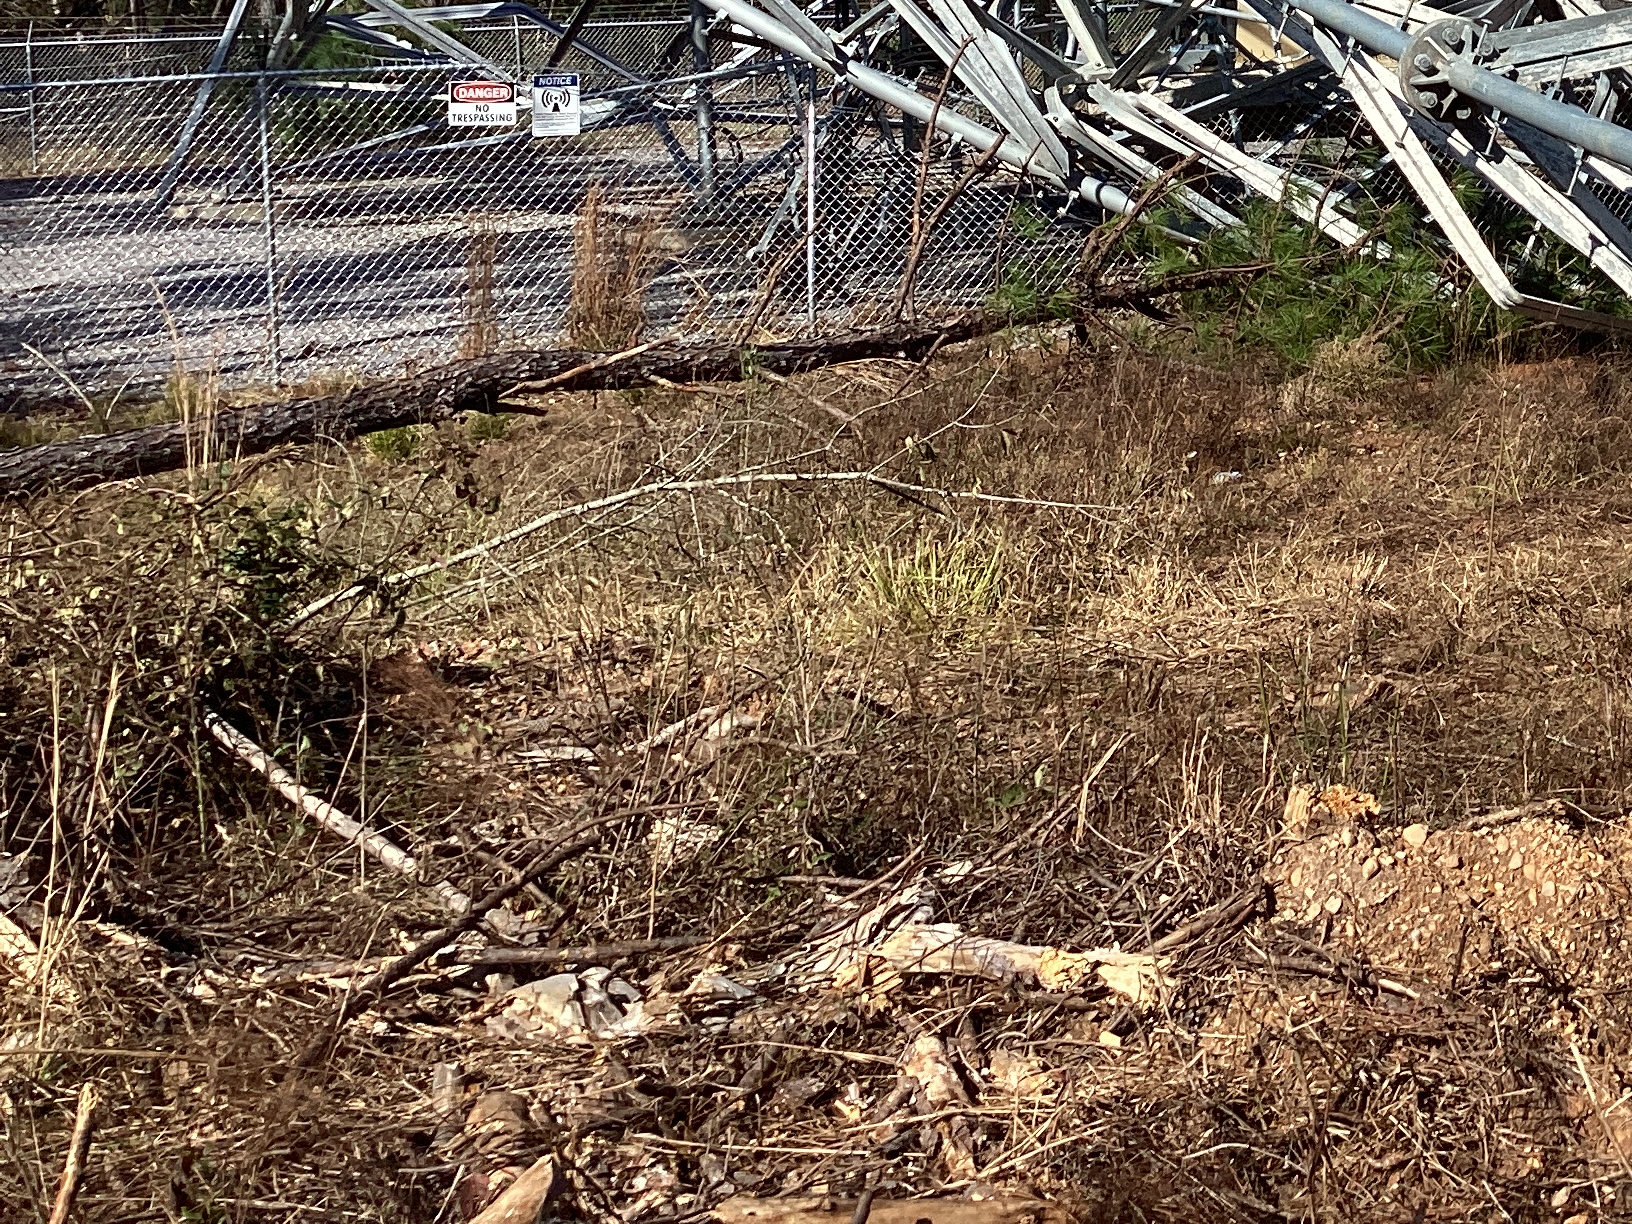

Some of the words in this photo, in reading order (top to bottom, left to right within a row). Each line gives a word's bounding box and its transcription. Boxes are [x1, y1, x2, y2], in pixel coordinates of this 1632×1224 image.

[538, 76, 572, 86] NOTICE
[459, 87, 509, 99] DANGER
[475, 104, 490, 113] NO
[452, 113, 513, 123] TRESPASSING
